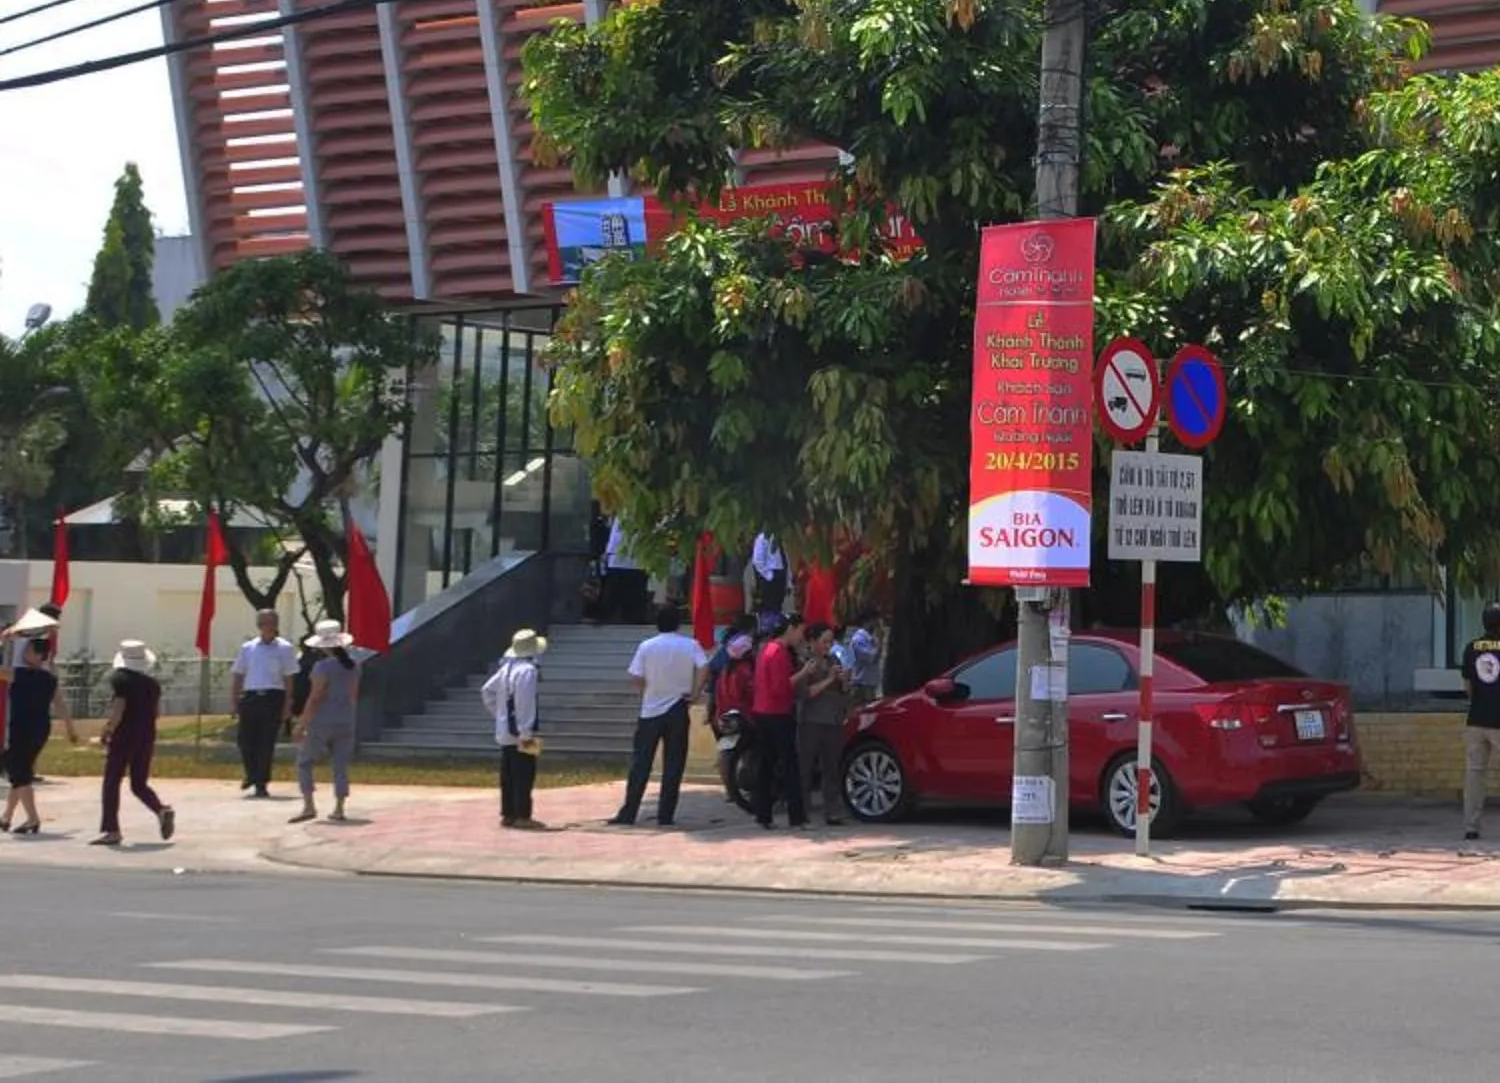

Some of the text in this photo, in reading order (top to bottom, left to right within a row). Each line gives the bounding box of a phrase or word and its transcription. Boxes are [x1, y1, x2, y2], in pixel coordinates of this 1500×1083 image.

[743, 189, 798, 210] Khánh
[986, 452, 1079, 470] 20/4/2015
[1013, 512, 1041, 525] BIA
[980, 527, 1074, 548] SAIGON
